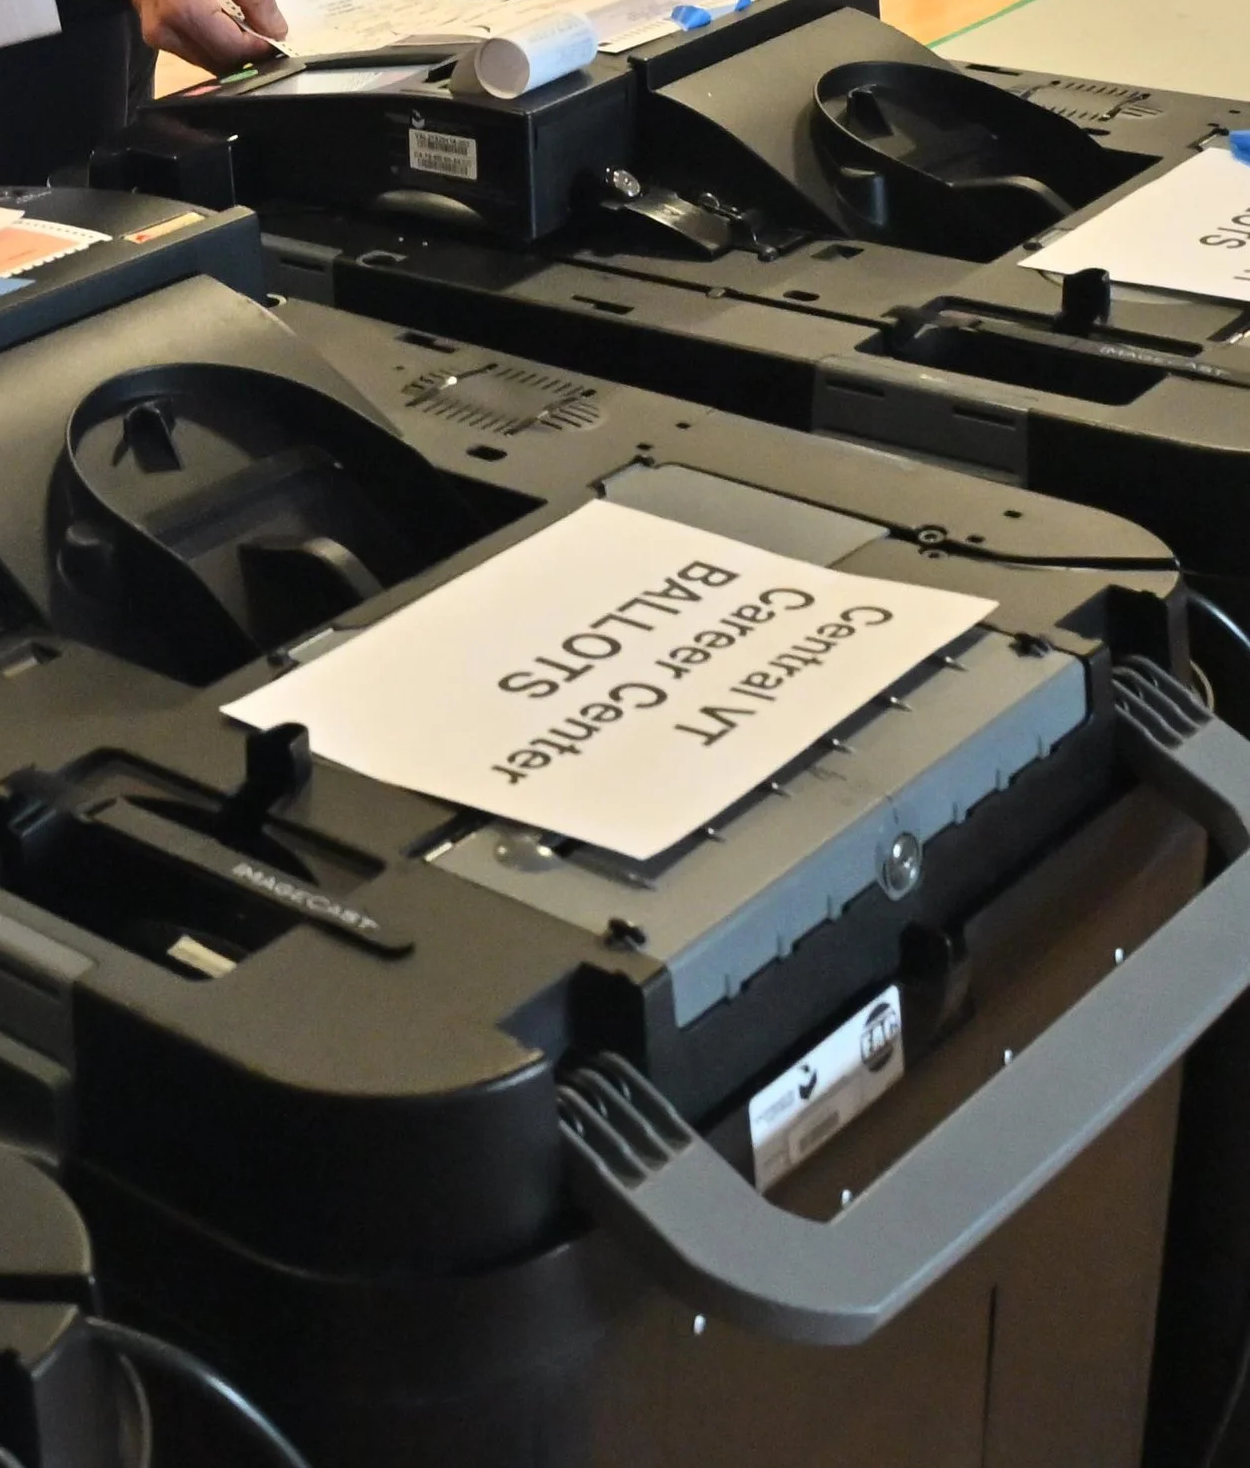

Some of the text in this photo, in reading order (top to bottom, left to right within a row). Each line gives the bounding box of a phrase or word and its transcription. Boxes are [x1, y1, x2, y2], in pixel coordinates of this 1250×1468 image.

[491, 586, 816, 785] Career Center
[497, 560, 741, 699] BALLOTS
[674, 605, 894, 748] Central VT
